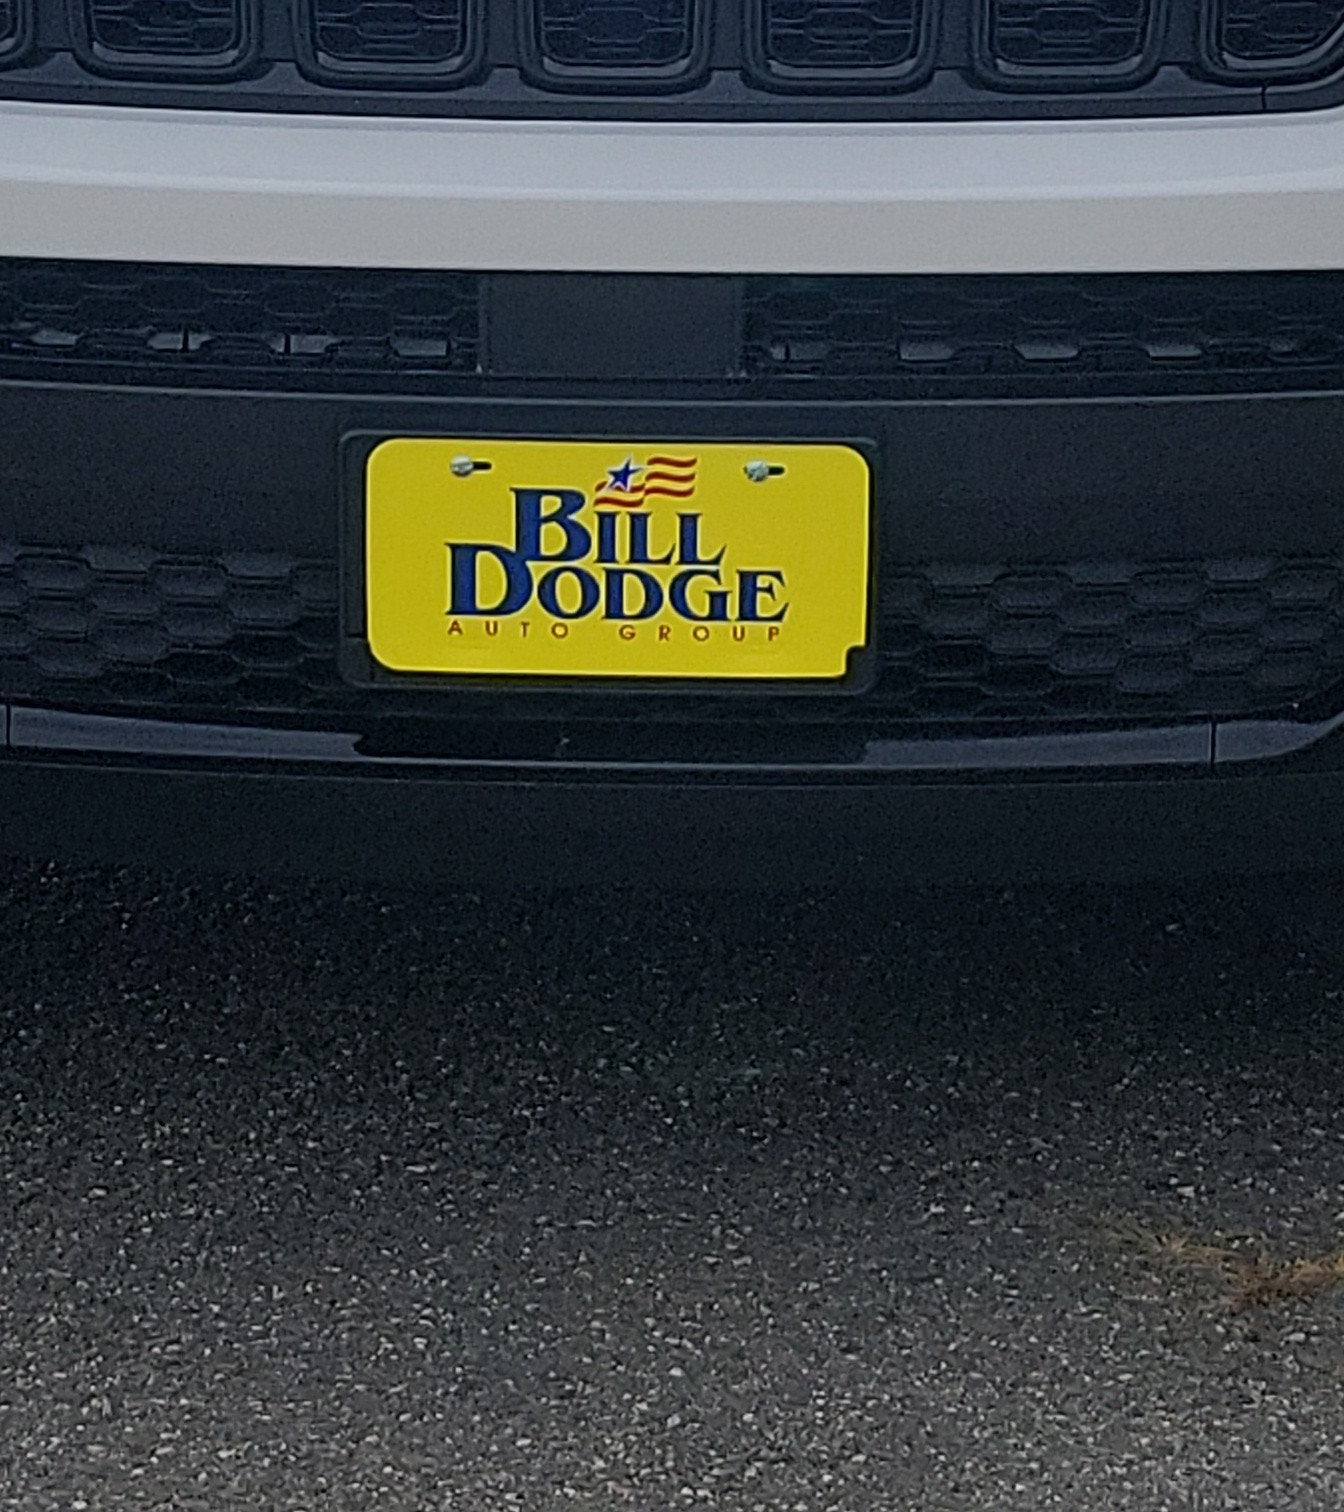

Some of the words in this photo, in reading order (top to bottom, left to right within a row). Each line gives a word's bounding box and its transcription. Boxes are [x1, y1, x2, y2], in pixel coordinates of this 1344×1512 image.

[509, 487, 727, 566] BILL
[444, 542, 790, 623] DODGE
[447, 619, 569, 640] AUTO
[618, 623, 781, 643] GROUP
